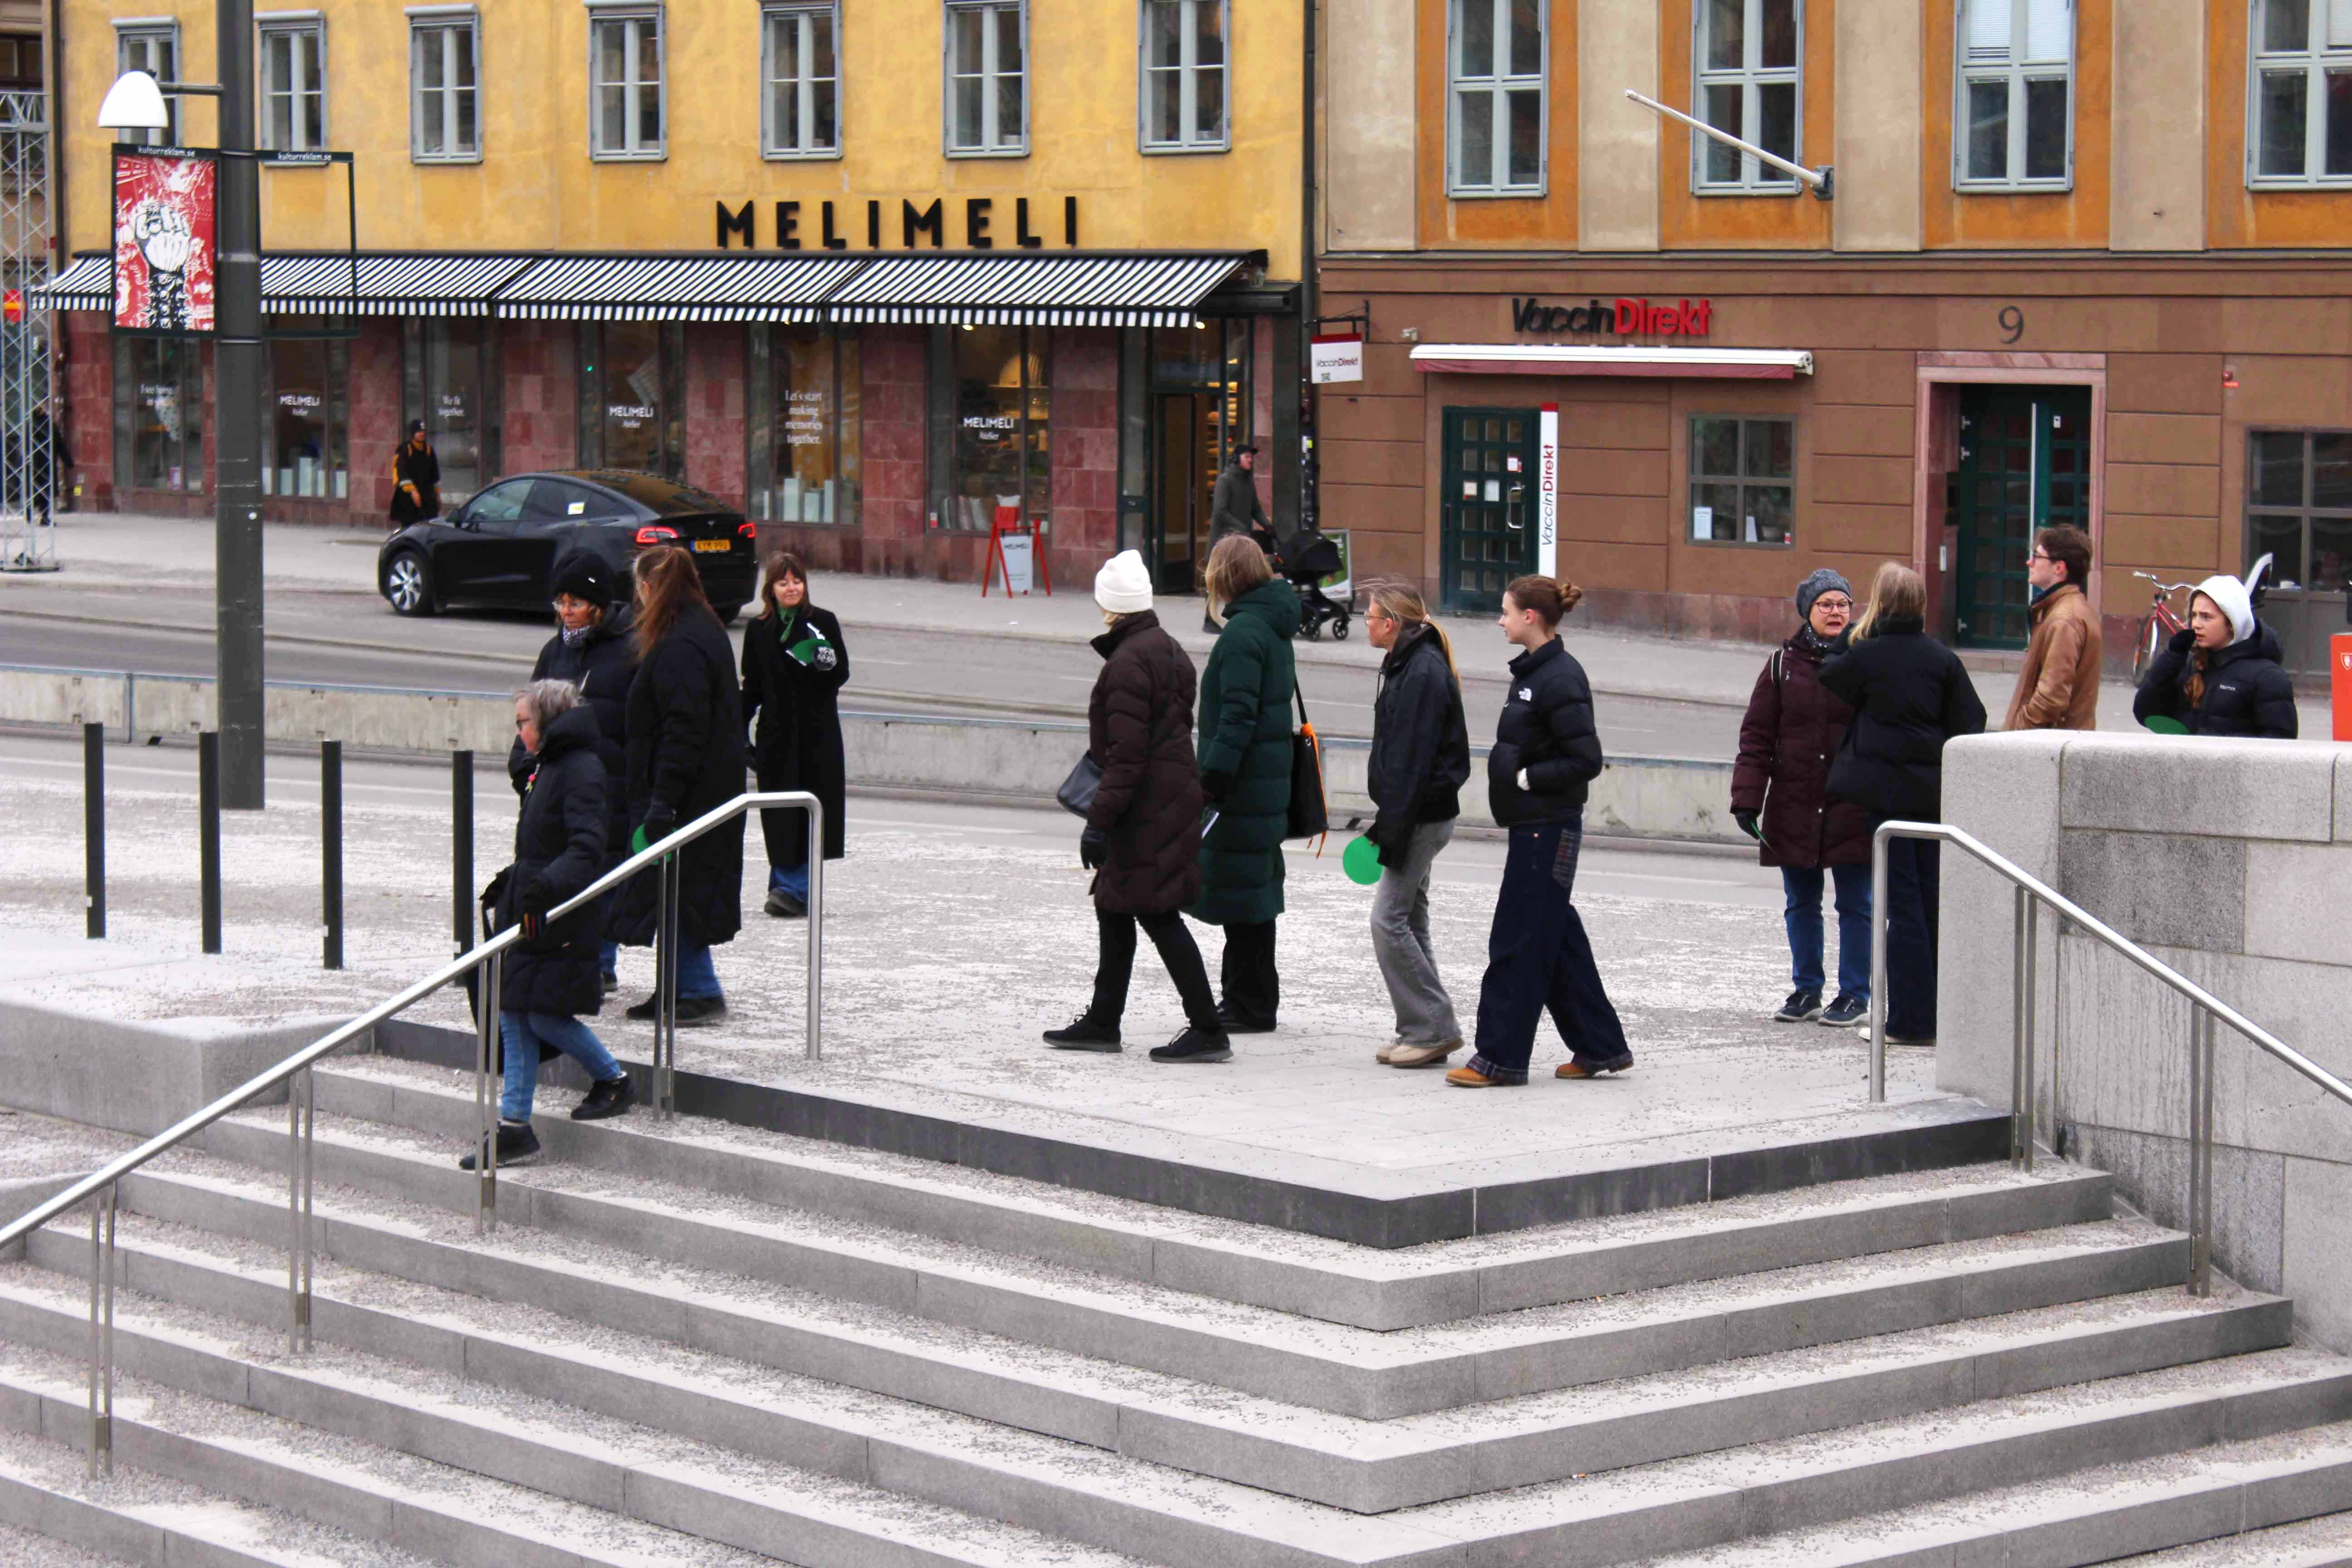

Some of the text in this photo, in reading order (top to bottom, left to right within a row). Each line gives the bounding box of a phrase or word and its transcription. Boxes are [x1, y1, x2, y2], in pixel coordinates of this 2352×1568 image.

[137, 145, 196, 157] kulturreklam.se
[277, 152, 331, 161] kulturreklam.se
[716, 196, 1077, 249] MELIMELI
[1511, 298, 1712, 335] VaccinDirekt
[1998, 305, 2024, 344] 9
[1316, 357, 1358, 367] VaccinDirekt
[280, 395, 320, 406] MELIMELI
[805, 392, 822, 402] start
[609, 406, 654, 417] MELIMELI
[789, 405, 819, 421] making
[785, 421, 823, 430] memories
[963, 416, 1014, 429] MELIMELI
[1542, 444, 1554, 546] VaccinDirekt
